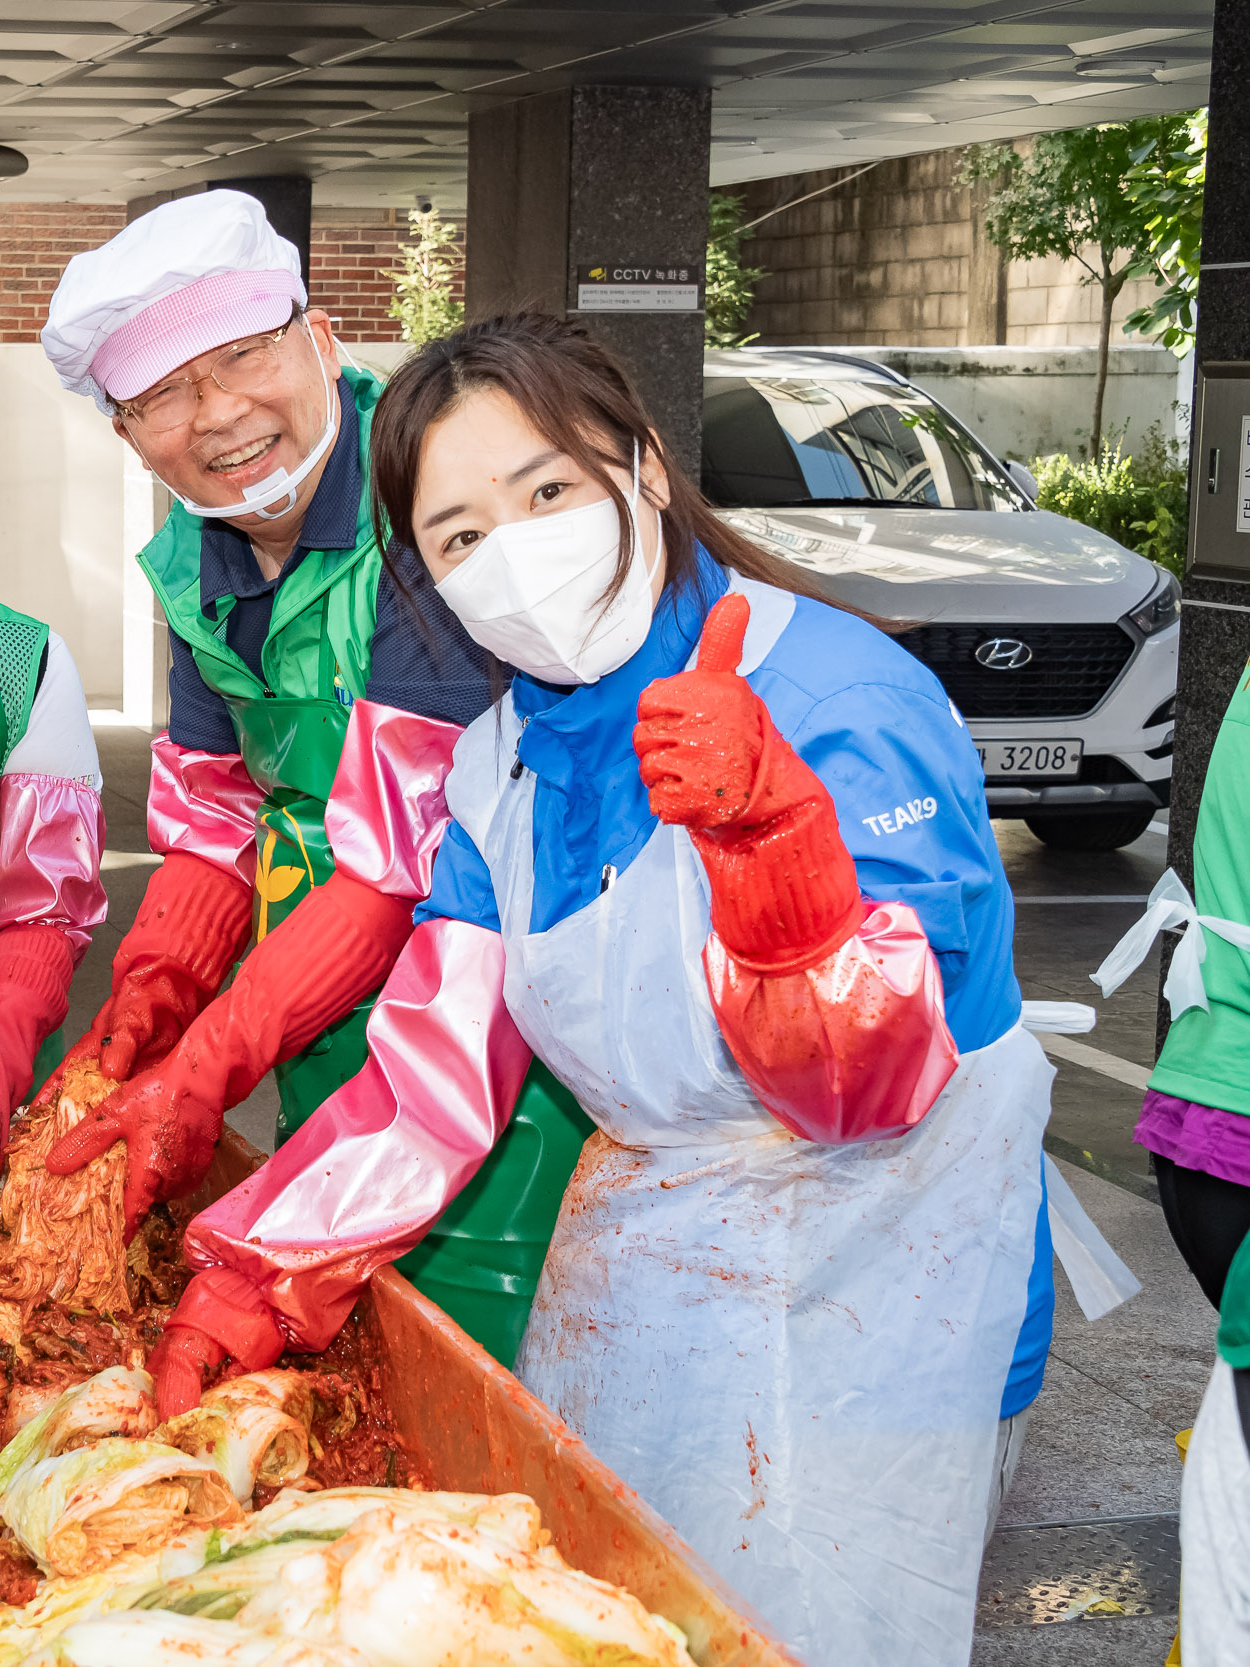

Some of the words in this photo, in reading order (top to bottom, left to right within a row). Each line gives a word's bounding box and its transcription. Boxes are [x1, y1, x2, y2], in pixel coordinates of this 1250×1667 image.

[613, 269, 651, 280] CCTV
[655, 269, 689, 281] 녹화중
[1000, 746, 1066, 770] 3208
